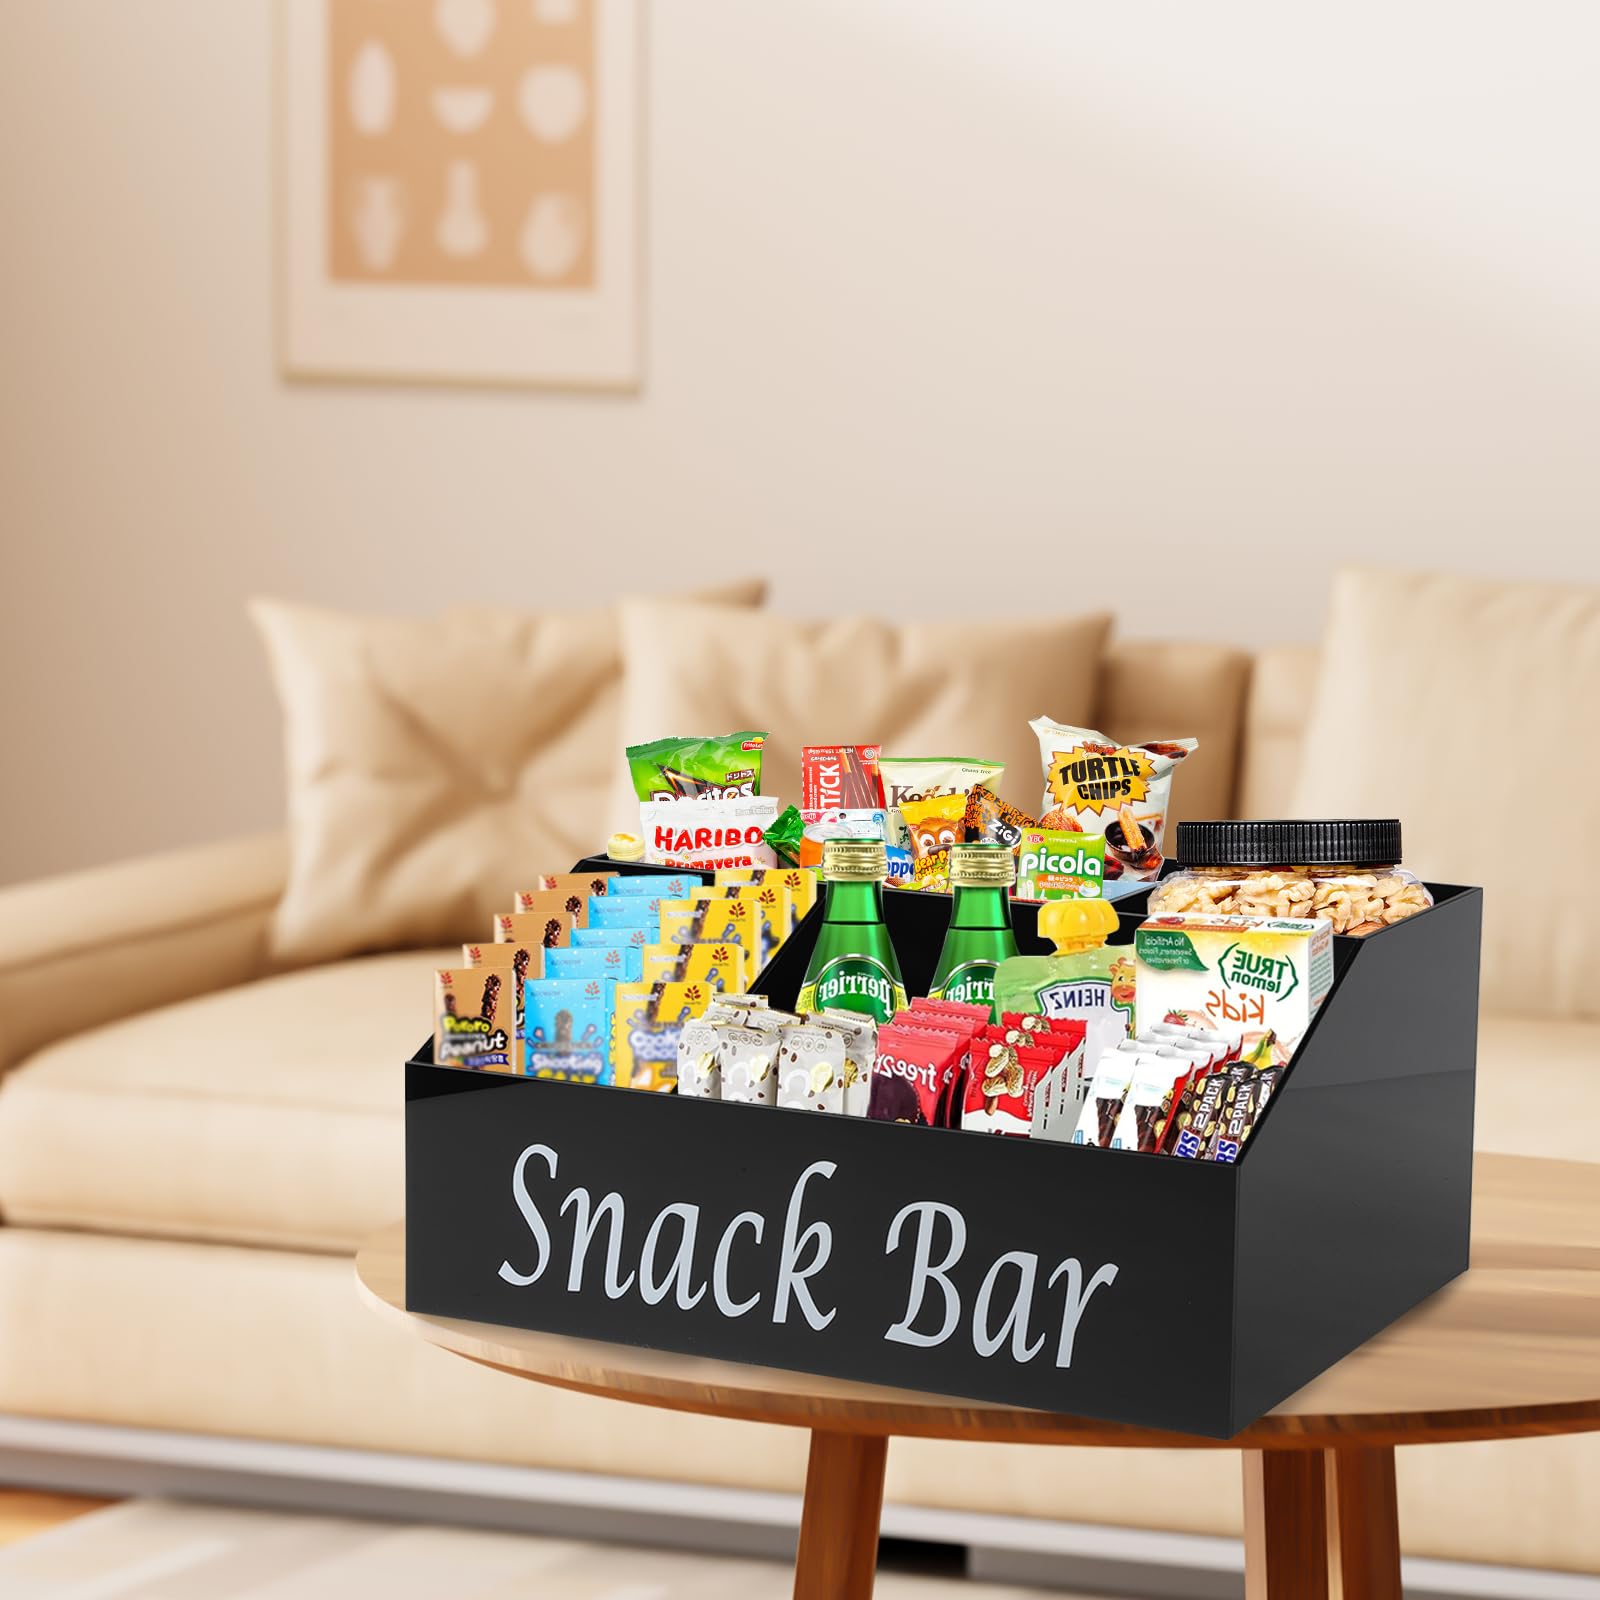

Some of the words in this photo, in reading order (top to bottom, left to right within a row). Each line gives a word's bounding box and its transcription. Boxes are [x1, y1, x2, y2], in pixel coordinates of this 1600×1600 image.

[1059, 756, 1141, 785] TURTLE
[1077, 778, 1131, 800] CHIPS
[654, 825, 764, 852] HARIBO
[664, 854, 752, 871] Primavera
[1020, 847, 1101, 877] picola
[497, 1142, 838, 1332] Snack
[883, 1200, 1121, 1369] Bar
